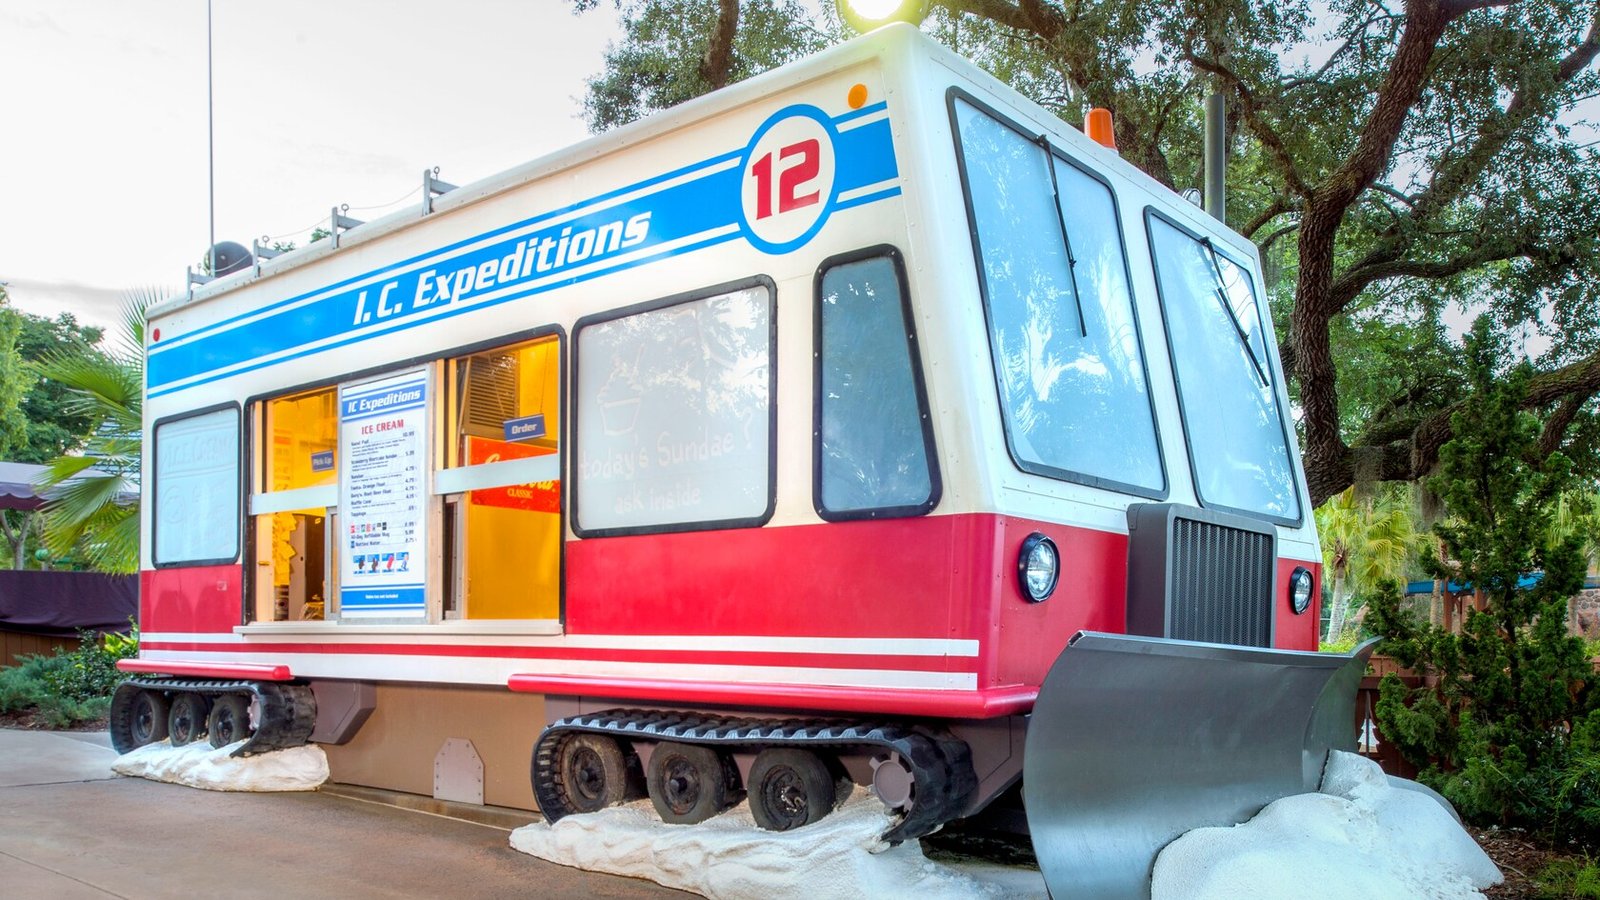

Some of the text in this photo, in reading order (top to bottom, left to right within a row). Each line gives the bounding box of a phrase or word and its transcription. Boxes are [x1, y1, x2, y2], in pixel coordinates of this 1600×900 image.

[752, 138, 820, 220] 12
[412, 210, 652, 309] Expeditions
[347, 390, 421, 414] IC Expeditions
[361, 419, 404, 435] ICE CREAM
[511, 422, 537, 435] Order
[579, 433, 649, 481] today's
[507, 488, 533, 499] CLASSIC
